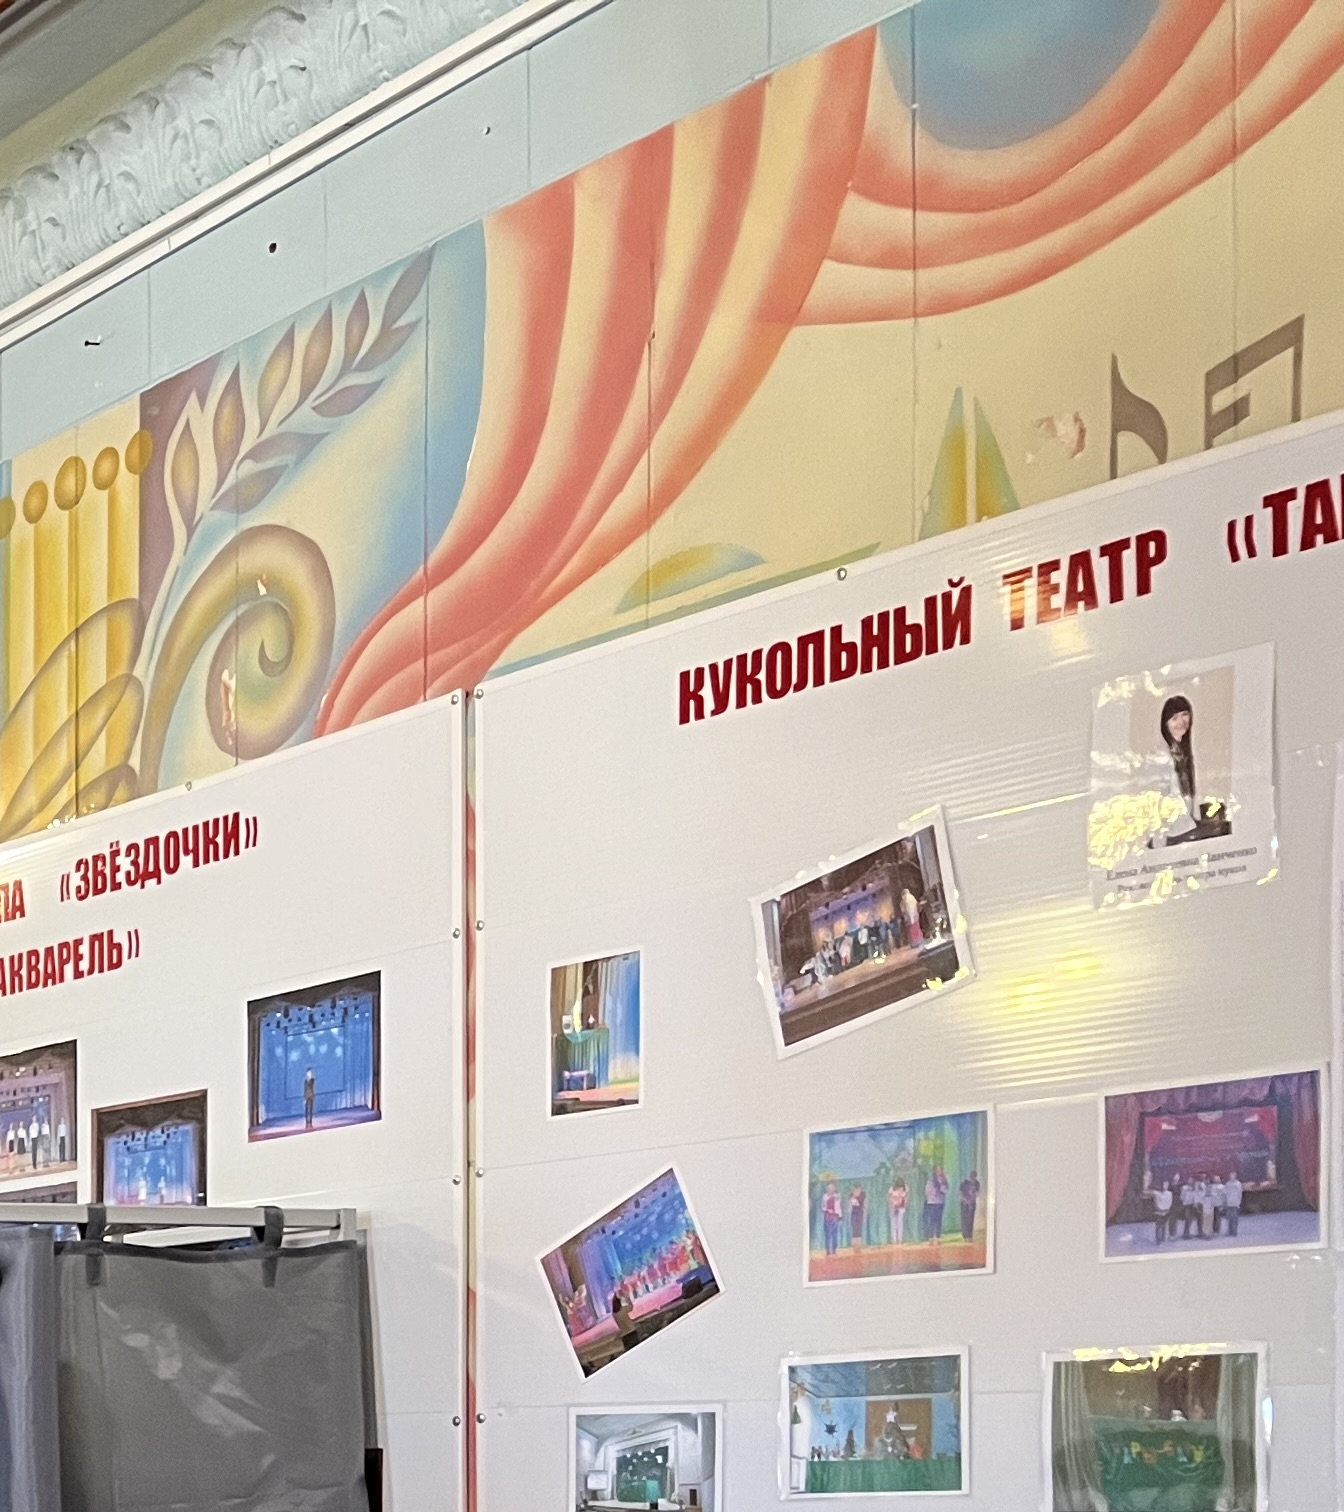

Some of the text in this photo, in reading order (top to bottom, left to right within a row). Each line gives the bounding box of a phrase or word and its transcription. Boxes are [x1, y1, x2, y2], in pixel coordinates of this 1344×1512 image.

[678, 473, 1344, 726] КУКОЛЬНЫЙ ТЕАТР «ТА
[60, 811, 258, 902] «ЗВЁЗДОЧКИ»
